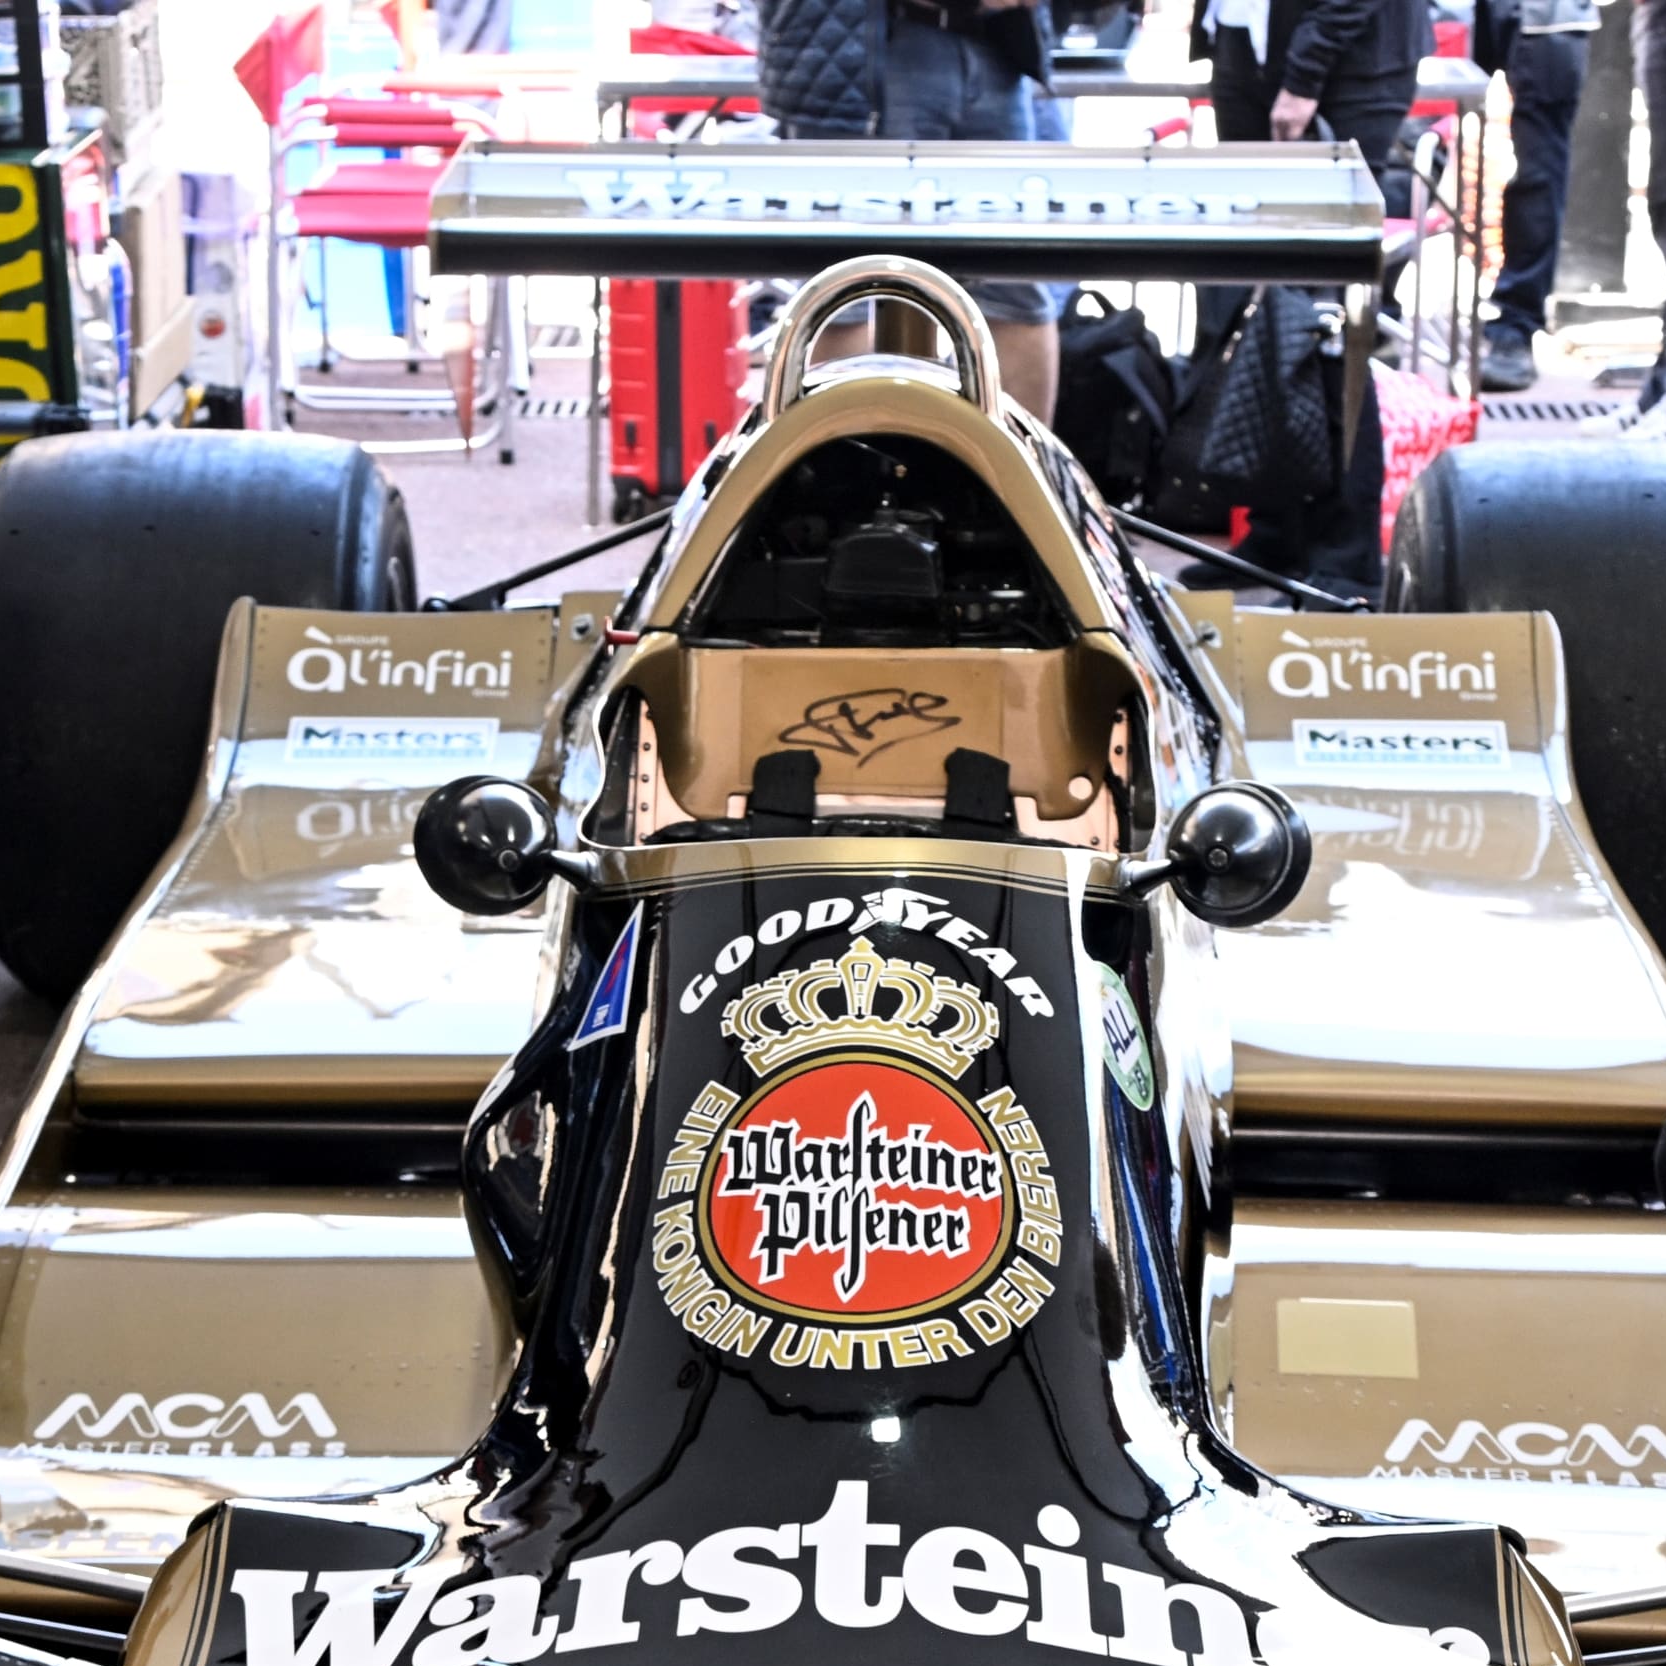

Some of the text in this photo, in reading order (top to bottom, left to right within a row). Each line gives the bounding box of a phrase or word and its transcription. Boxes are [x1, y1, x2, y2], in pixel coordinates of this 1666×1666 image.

[562, 167, 1261, 221] Warsteiner
[303, 726, 483, 746] Masters
[1309, 729, 1493, 751] Masters
[657, 1080, 741, 1199] EINE
[976, 1086, 1063, 1266] BIEREN
[959, 1256, 1055, 1346] DEN
[770, 1317, 975, 1370] UNTER
[34, 1392, 338, 1439] MCM
